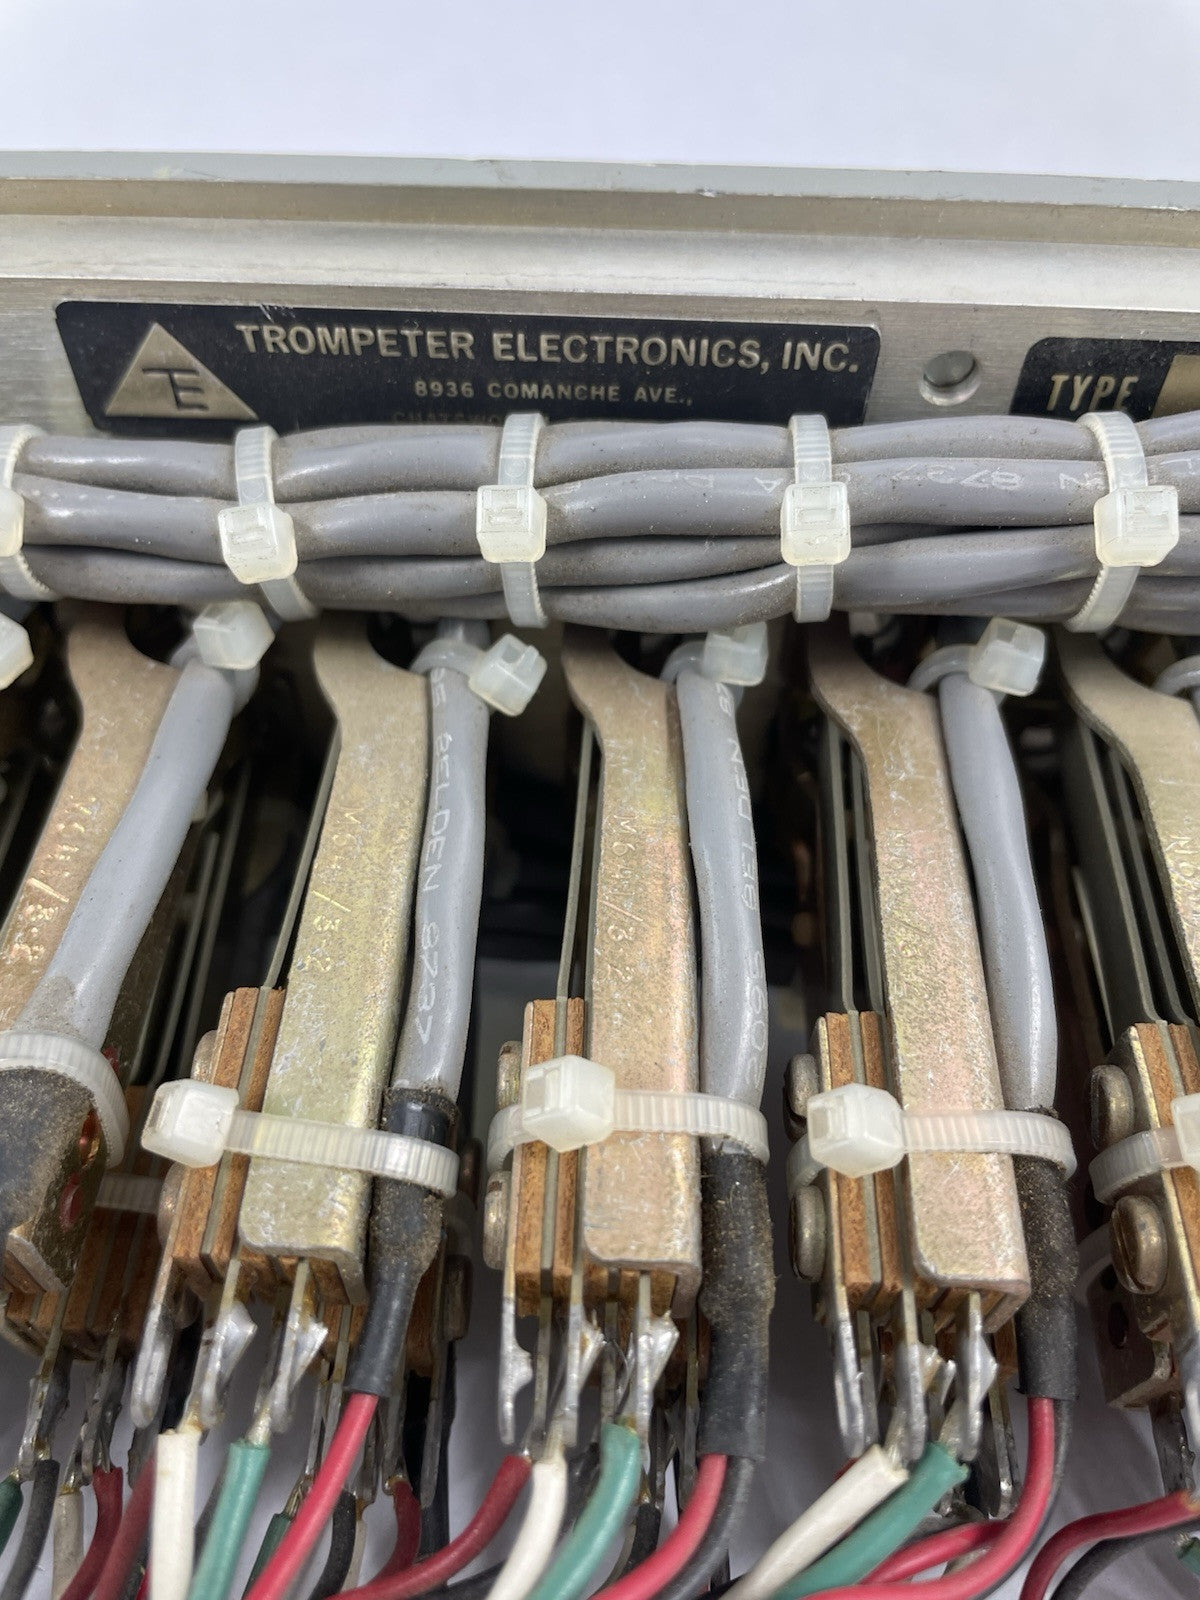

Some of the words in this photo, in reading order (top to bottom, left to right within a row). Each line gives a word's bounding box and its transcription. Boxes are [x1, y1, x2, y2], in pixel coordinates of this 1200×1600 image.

[235, 322, 475, 361] TROMPETER
[491, 332, 769, 374] ELECTRONICS,
[780, 341, 859, 373] INC.
[414, 381, 475, 398] 8936
[486, 382, 621, 402] COMANCHE
[634, 386, 693, 406] AVE.,
[1046, 373, 1140, 412] TYPE
[422, 732, 452, 893] BELDEN
[727, 738, 759, 913] BELDEN
